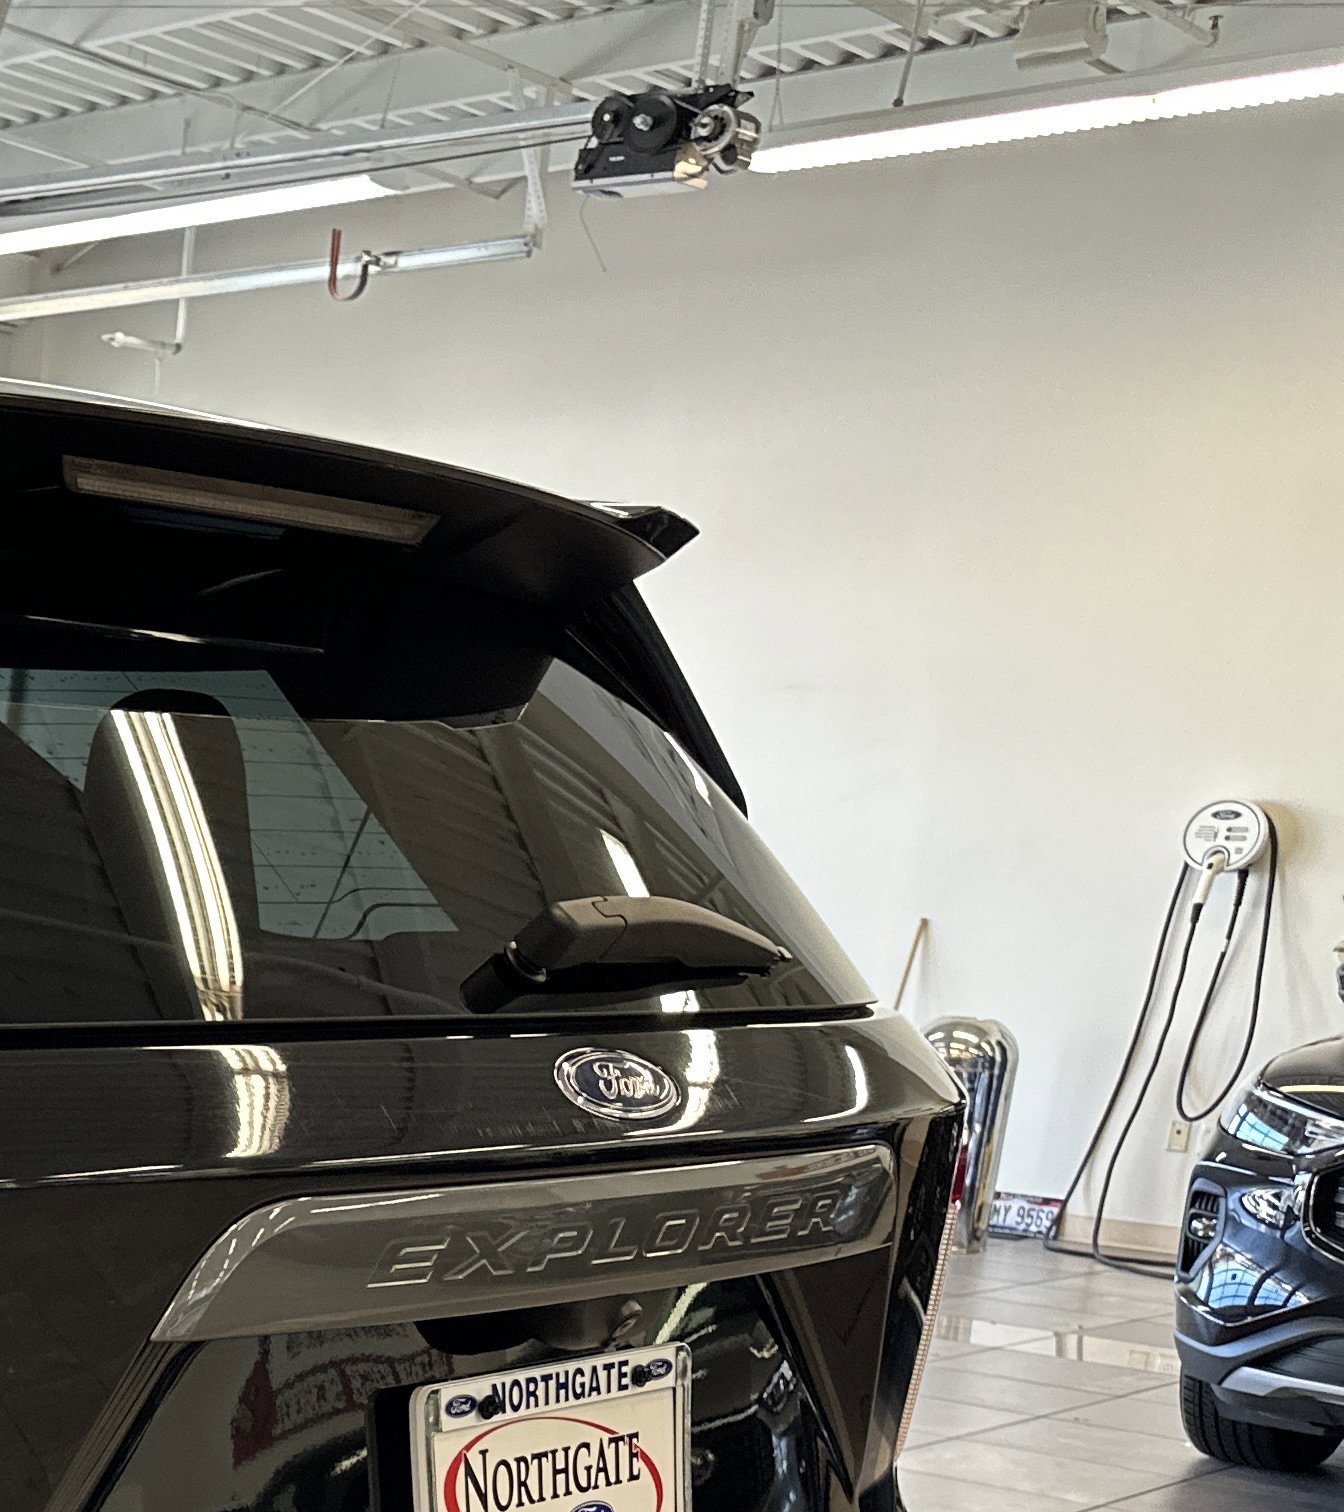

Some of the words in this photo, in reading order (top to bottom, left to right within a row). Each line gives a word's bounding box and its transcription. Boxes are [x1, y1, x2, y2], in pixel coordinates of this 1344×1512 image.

[592, 1061, 661, 1100] Ford
[364, 1190, 842, 1289] EXPLORER
[491, 1359, 630, 1414] NORTHGATE
